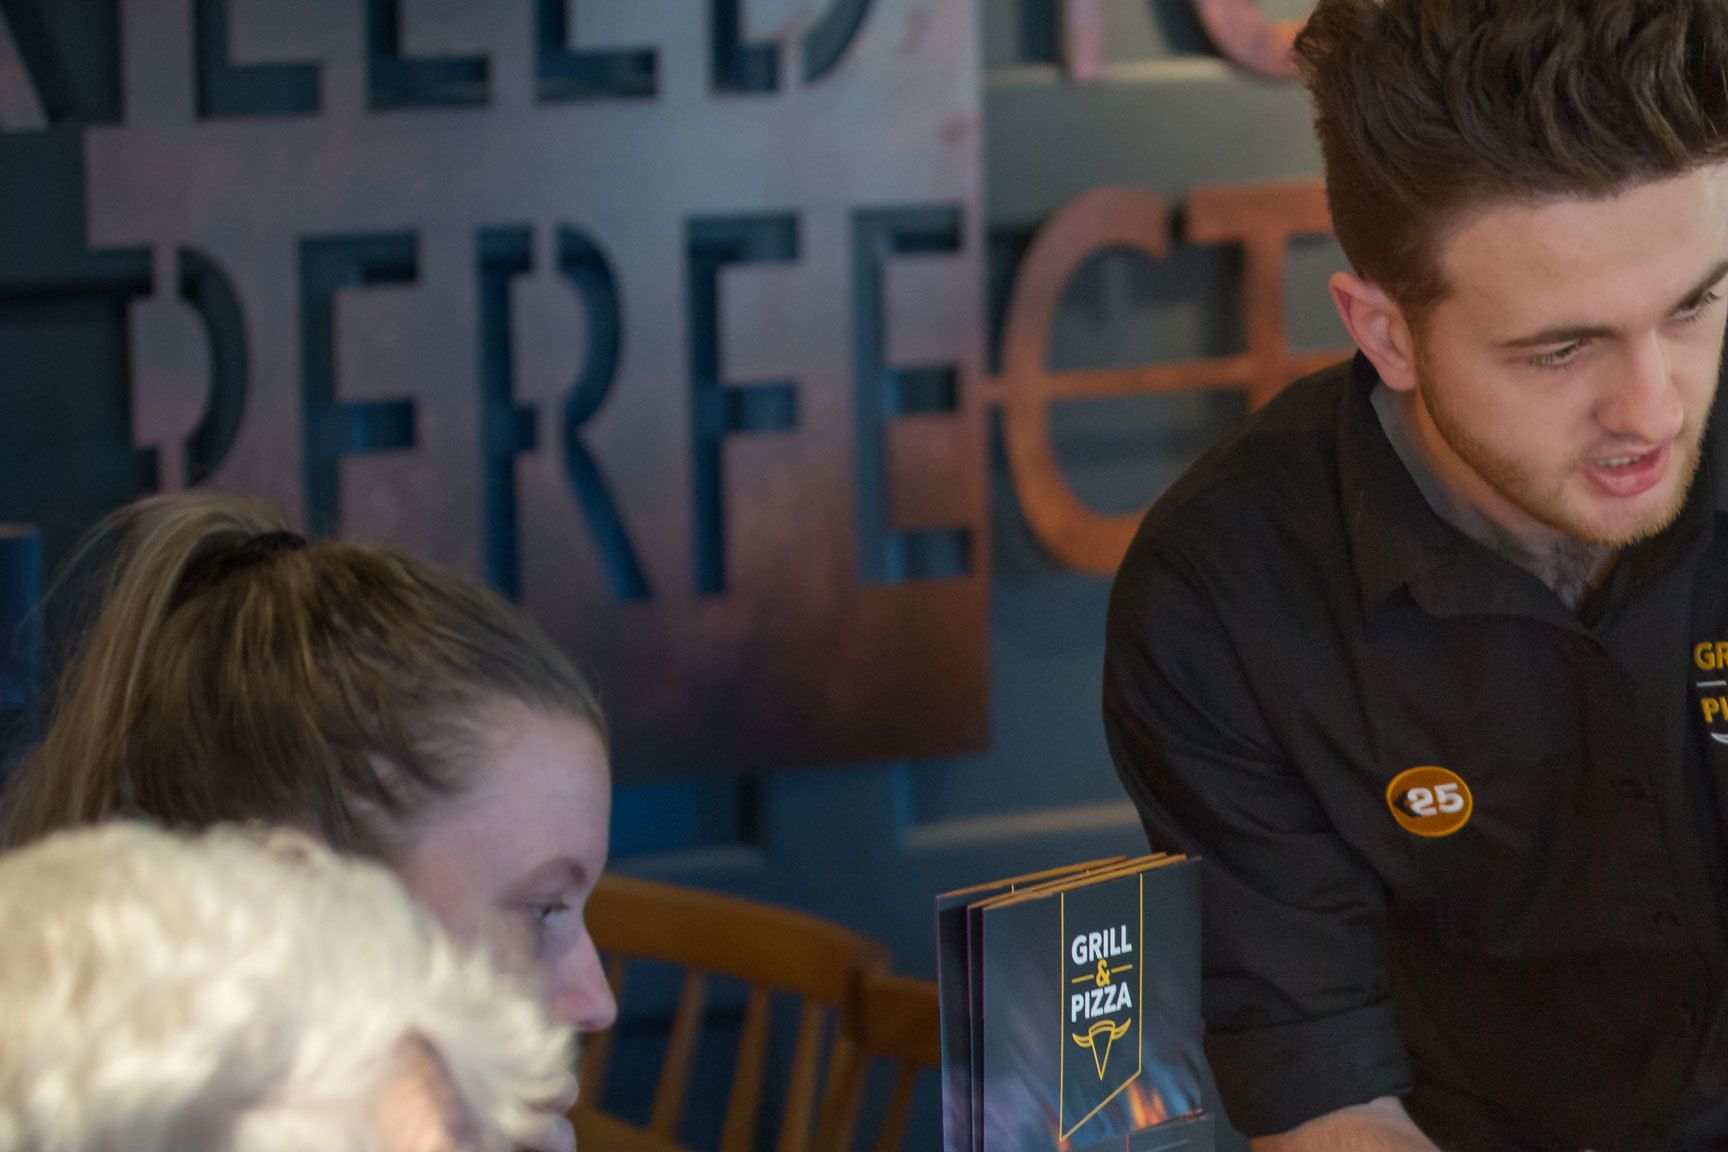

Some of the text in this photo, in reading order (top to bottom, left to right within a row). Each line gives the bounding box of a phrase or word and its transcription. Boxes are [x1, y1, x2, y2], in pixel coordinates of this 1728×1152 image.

[1406, 783, 1464, 816] 25
[1071, 924, 1132, 966] GRILL
[1096, 959, 1110, 987] &
[1071, 981, 1132, 1023] PIZZA
